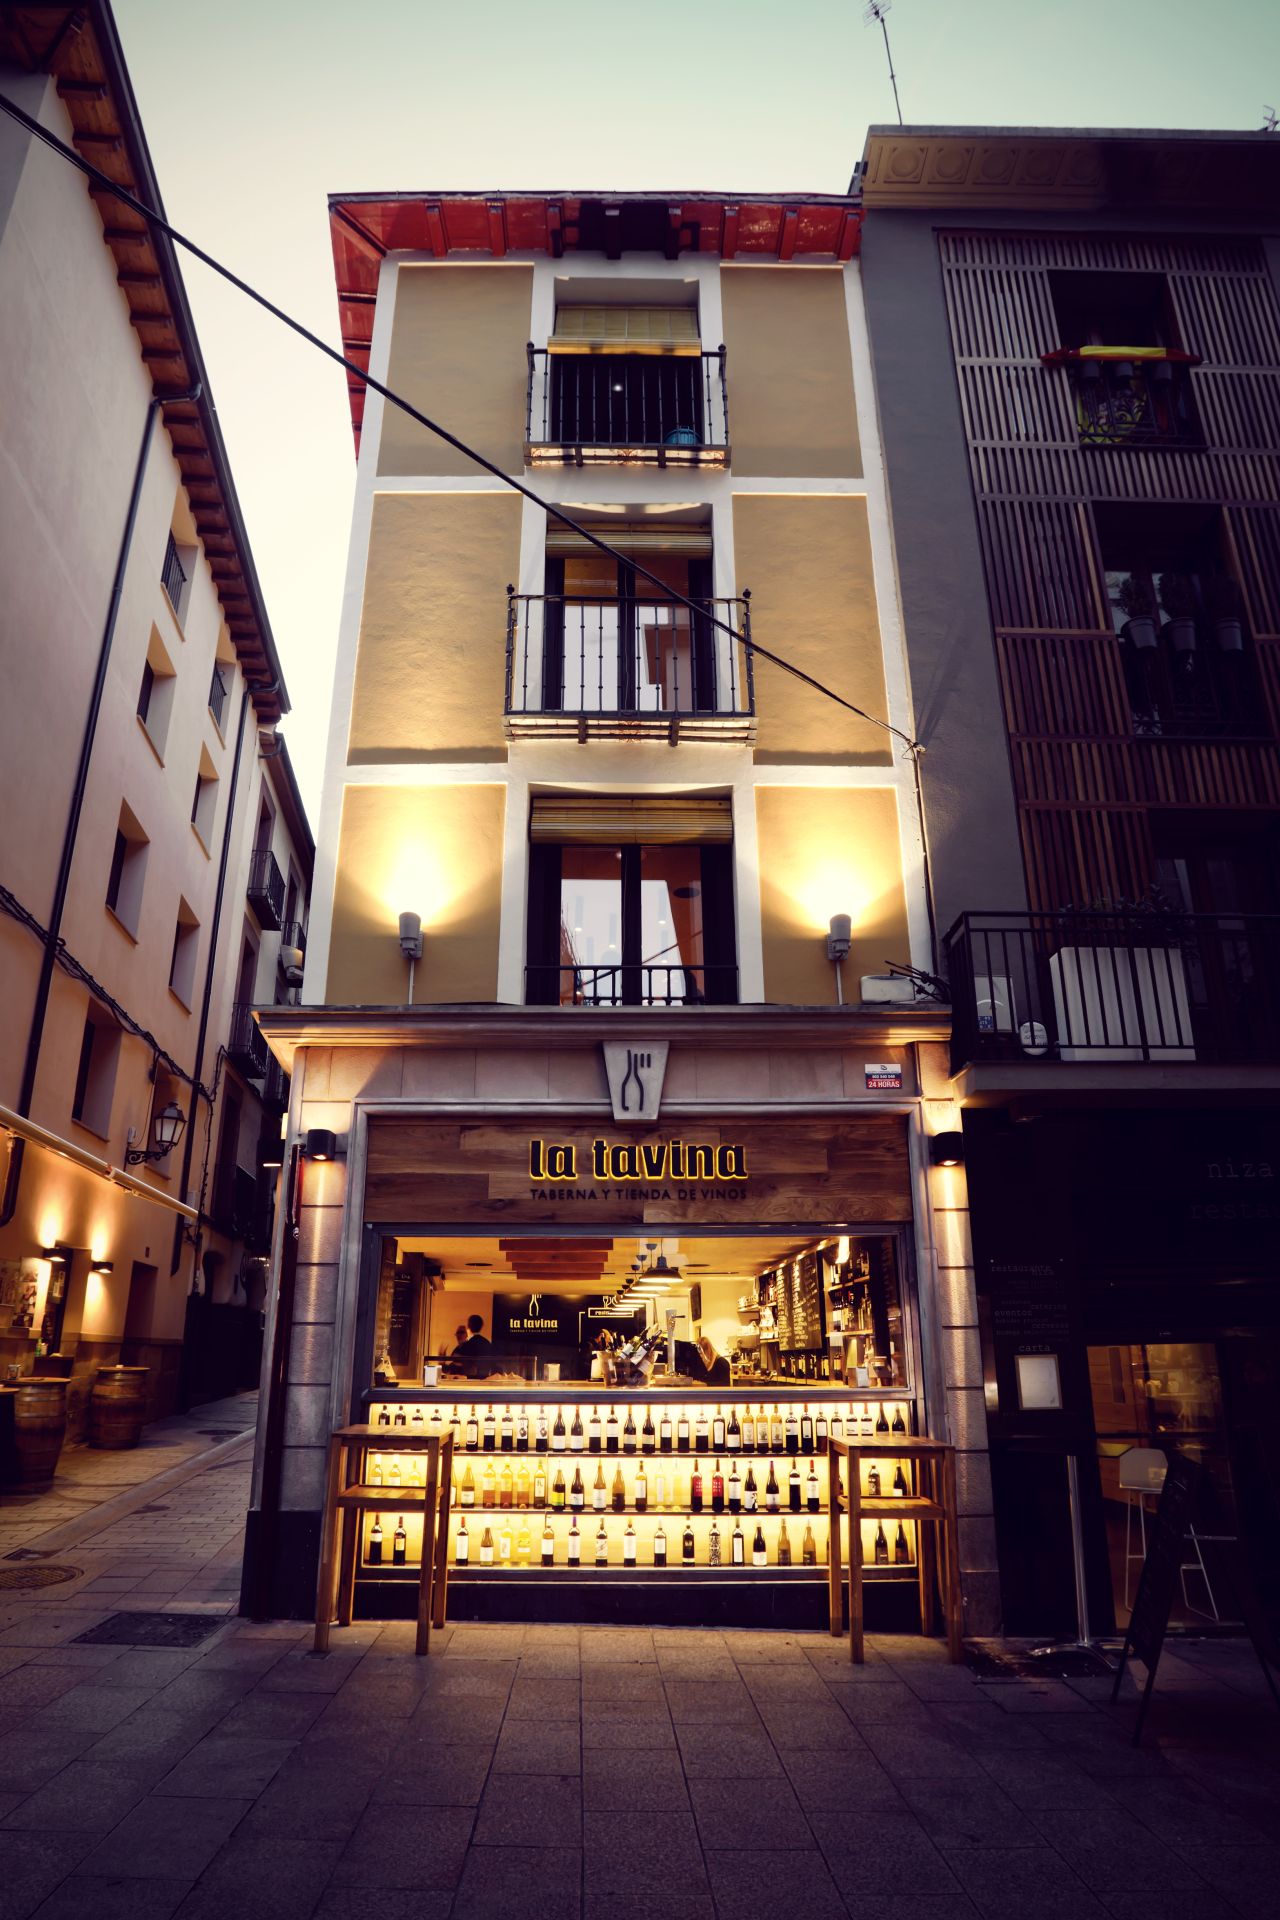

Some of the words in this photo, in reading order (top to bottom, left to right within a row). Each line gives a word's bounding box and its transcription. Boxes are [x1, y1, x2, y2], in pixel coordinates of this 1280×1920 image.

[530, 1139, 578, 1181] la
[592, 1139, 749, 1181] tavina
[1206, 1157, 1276, 1179] niza
[530, 1188, 597, 1201] TABERNA
[602, 1188, 611, 1200] Y
[616, 1188, 671, 1200] TIENDA
[677, 1188, 697, 1200] DE
[701, 1188, 747, 1200] VINOS
[510, 1318, 521, 1328] la
[523, 1318, 558, 1328] tavina
